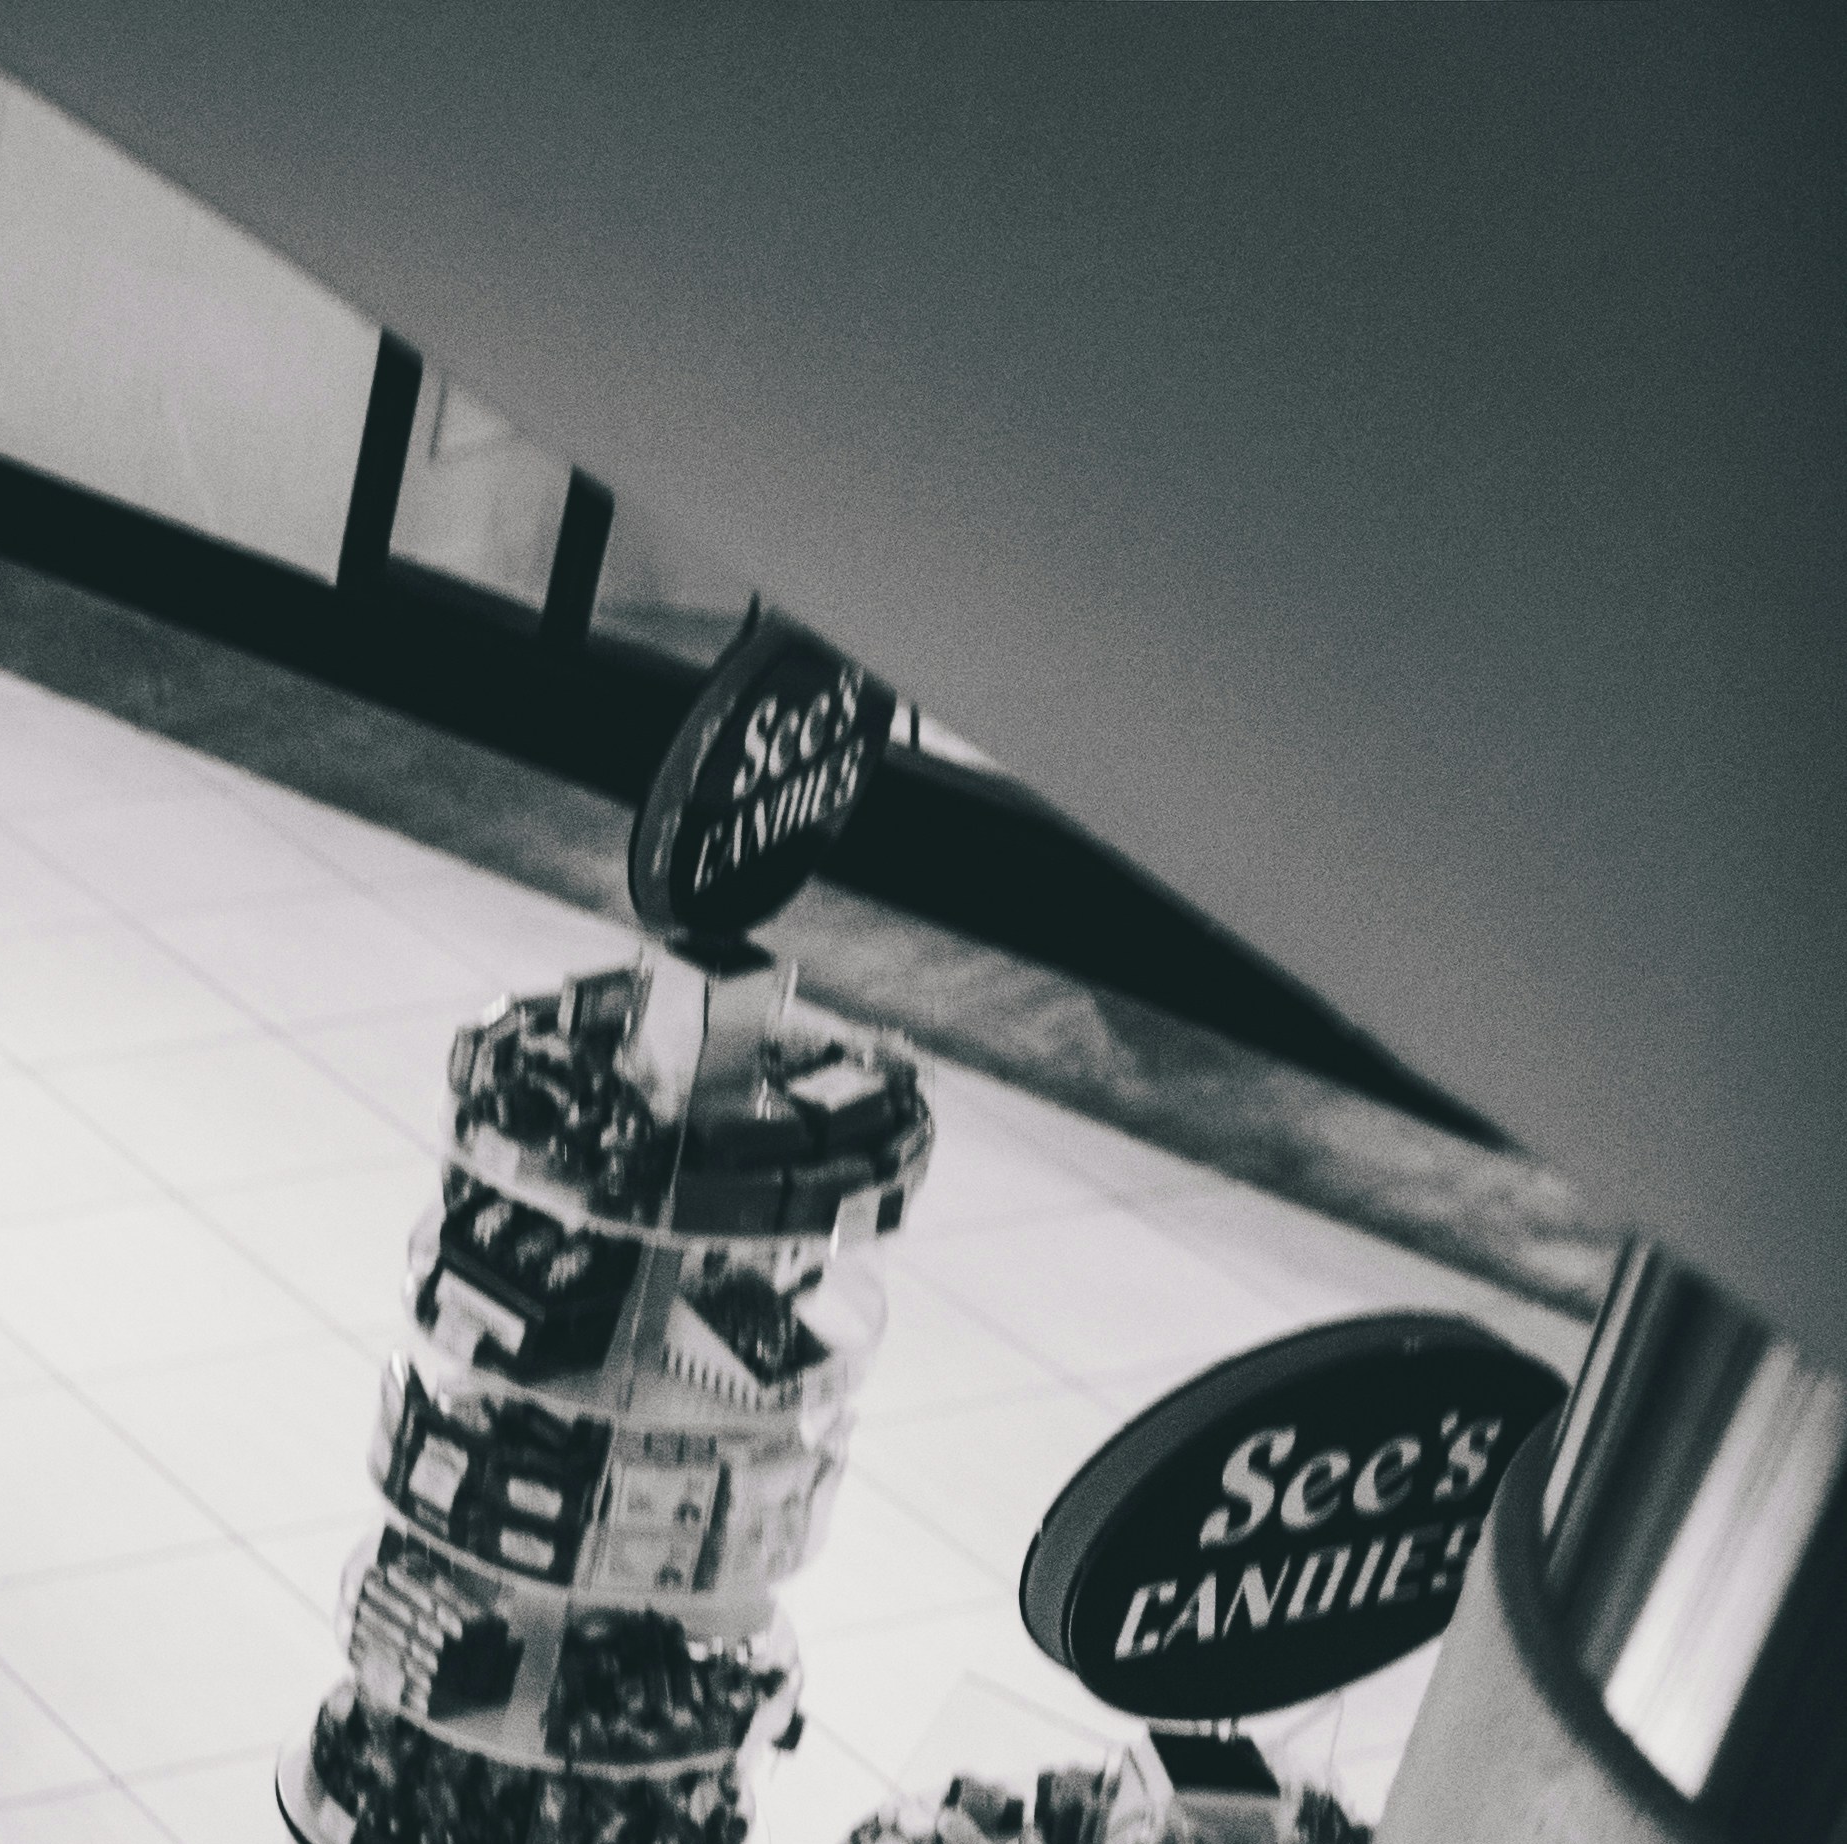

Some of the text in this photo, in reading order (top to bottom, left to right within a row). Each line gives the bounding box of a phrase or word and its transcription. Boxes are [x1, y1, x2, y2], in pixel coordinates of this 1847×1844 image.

[733, 664, 865, 800] See's
[694, 737, 865, 894] CANDIES
[1197, 1408, 1503, 1553] See's
